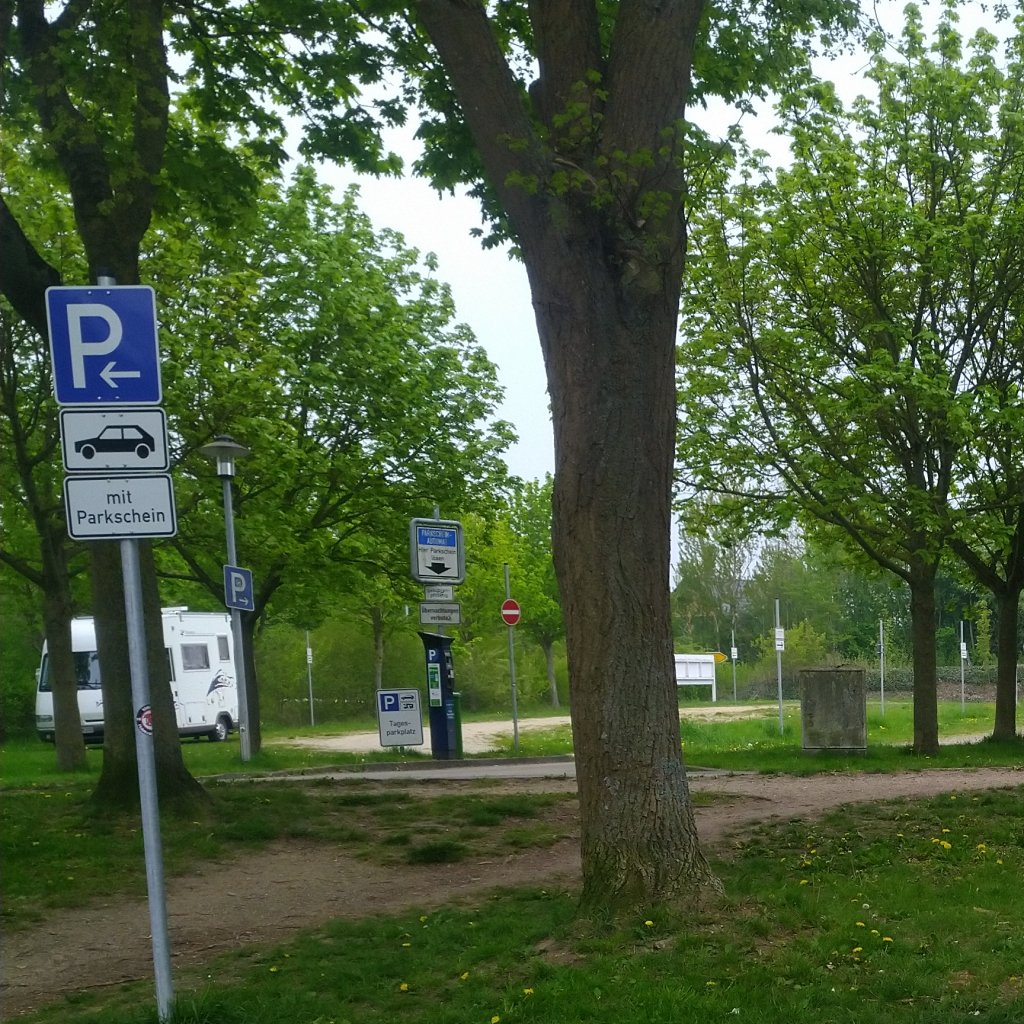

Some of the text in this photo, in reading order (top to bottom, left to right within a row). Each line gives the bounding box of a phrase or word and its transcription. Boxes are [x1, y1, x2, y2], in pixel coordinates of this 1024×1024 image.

[66, 303, 123, 389] P
[106, 489, 133, 504] mit
[77, 508, 166, 525] Parkschein
[230, 571, 246, 603] P
[428, 649, 436, 661] P
[383, 695, 395, 710] P
[389, 720, 412, 728] Tages-
[386, 728, 416, 736] parkplatz
